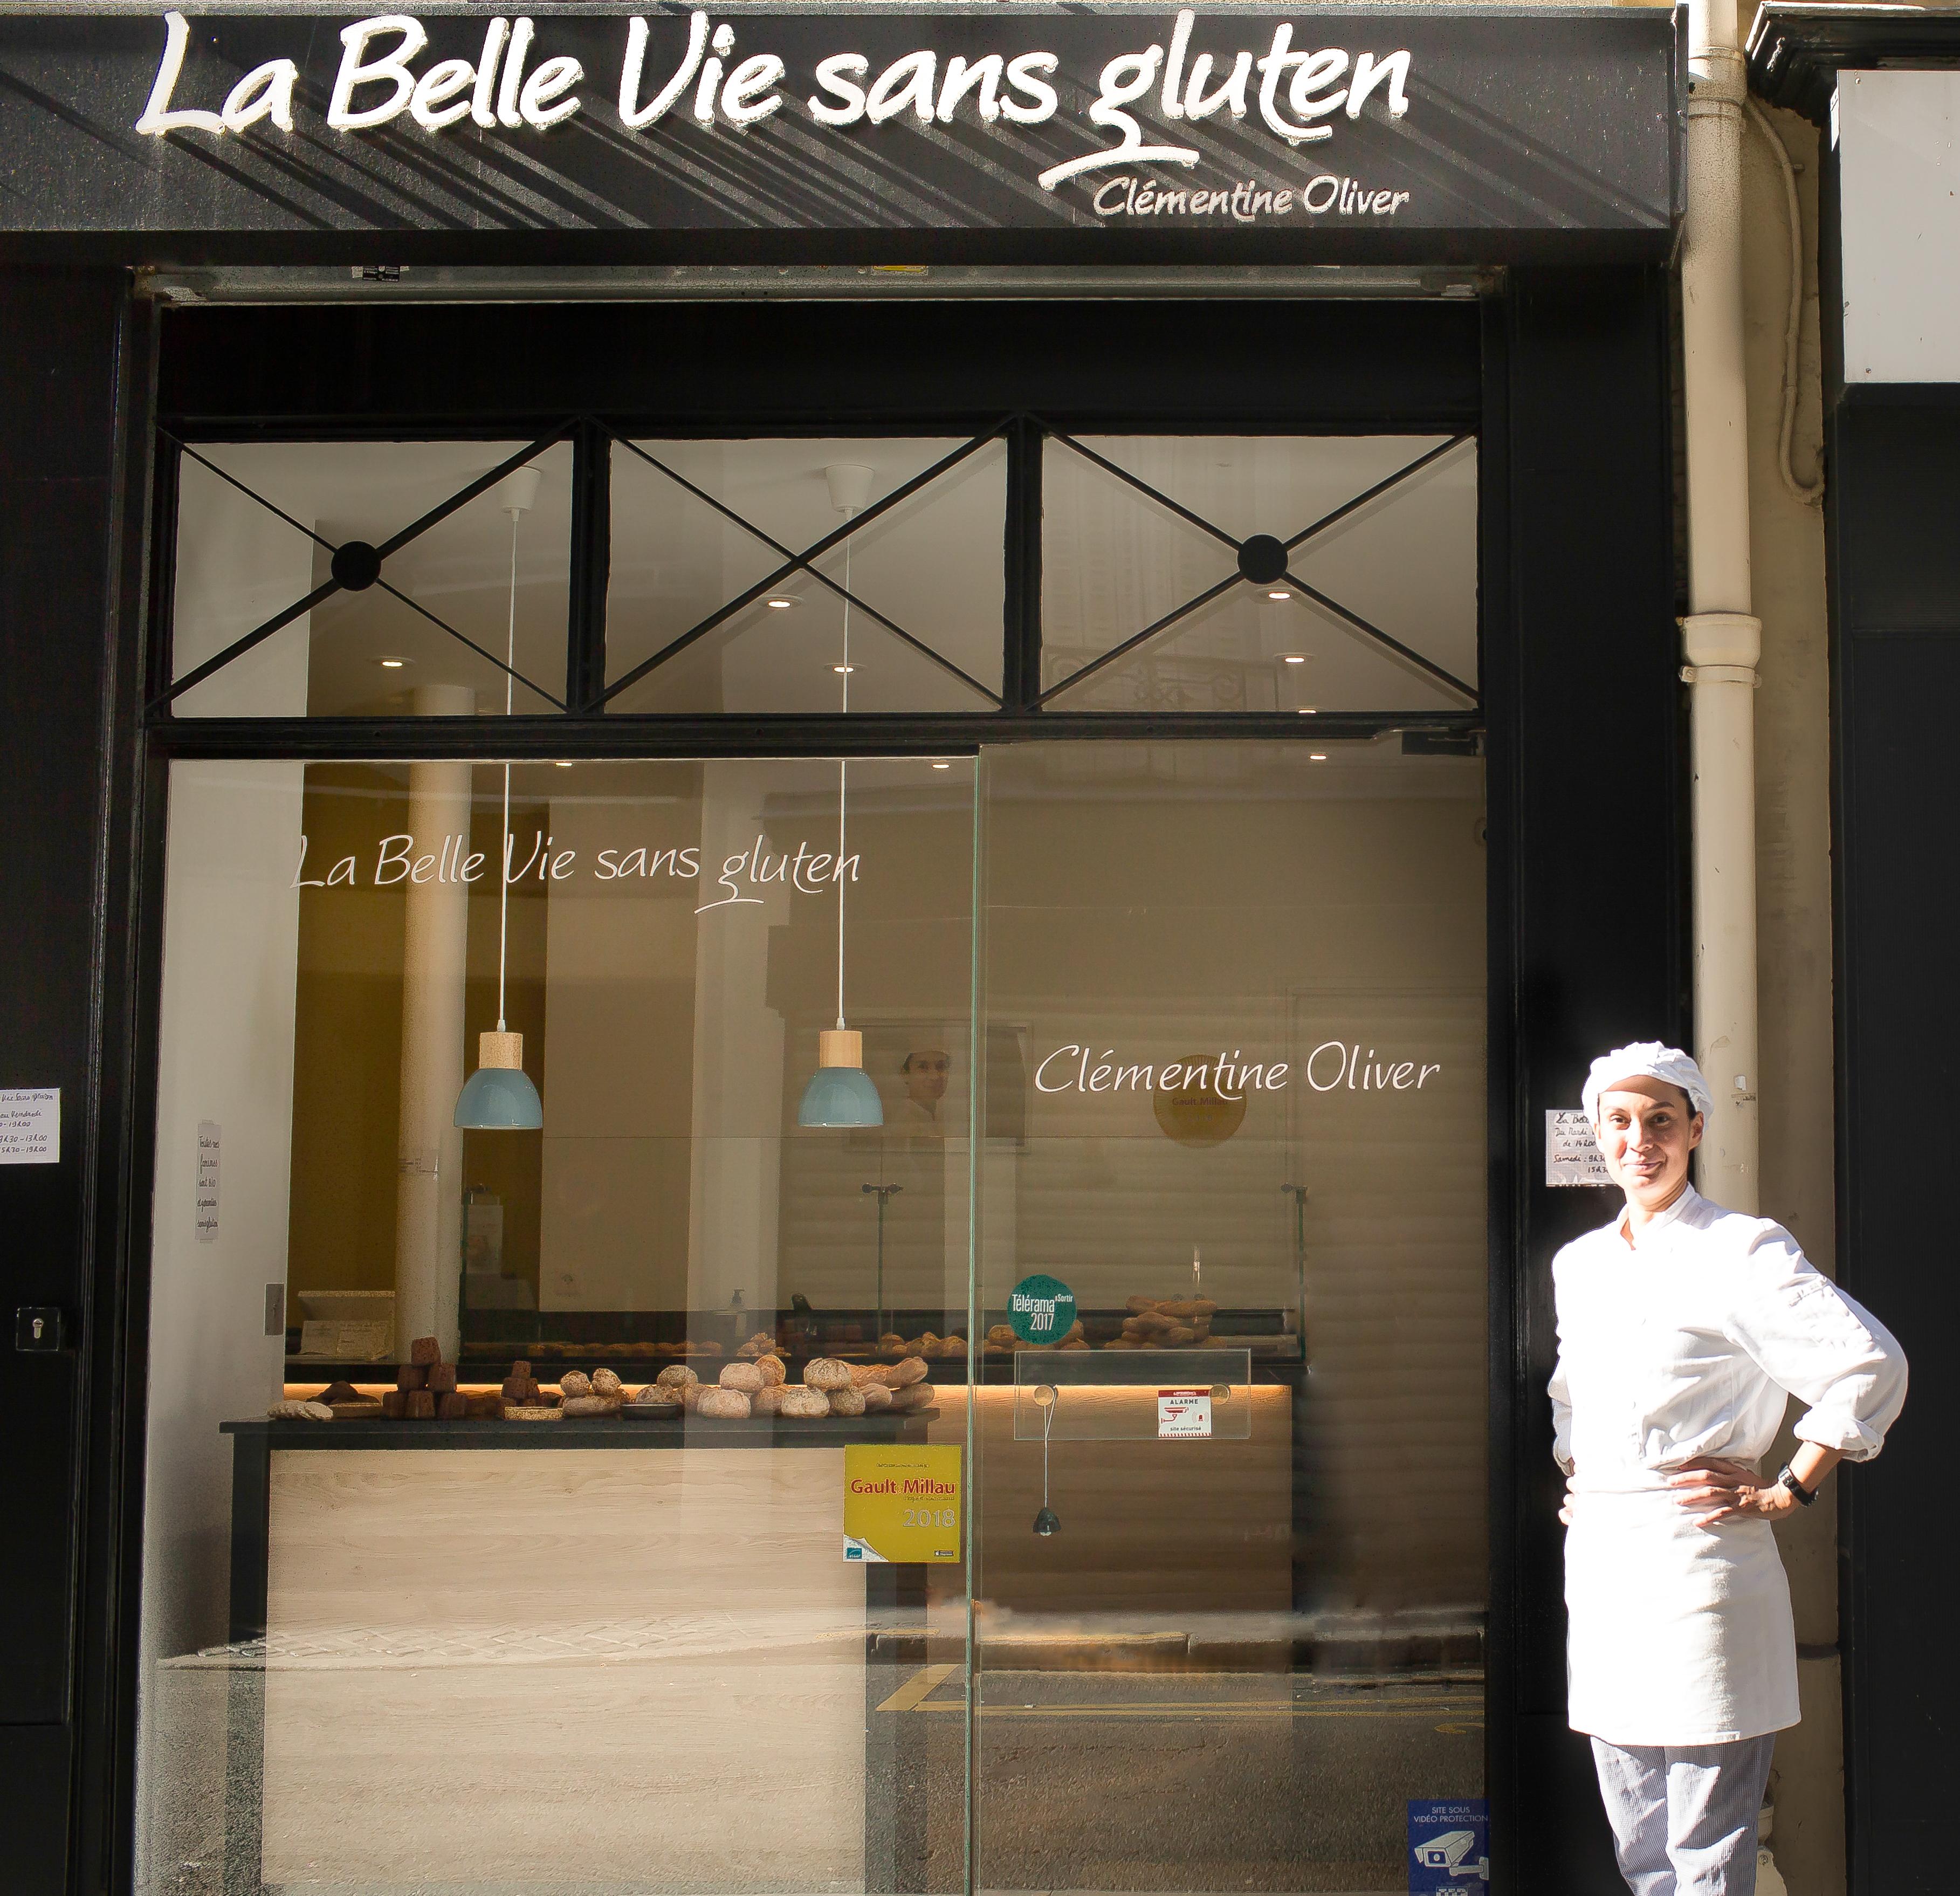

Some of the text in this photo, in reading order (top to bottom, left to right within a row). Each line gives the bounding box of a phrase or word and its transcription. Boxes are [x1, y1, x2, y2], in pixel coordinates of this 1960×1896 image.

[134, 8, 1412, 191] La Belle Vie sans gluten
[1093, 173, 1410, 223] Clémentine Oliver
[290, 830, 861, 915] La Belle Vie sans gluten
[1034, 1041, 1441, 1101] Clémentine Oliver
[1553, 1154, 1581, 1163] Samedi
[1012, 1294, 1055, 1313] Télérama
[1030, 1313, 1055, 1331] 2017
[850, 1478, 897, 1494] Gault
[903, 1478, 955, 1494] Millau
[902, 1508, 956, 1528] 2018
[1413, 1814, 1438, 1823] VIDÉO
